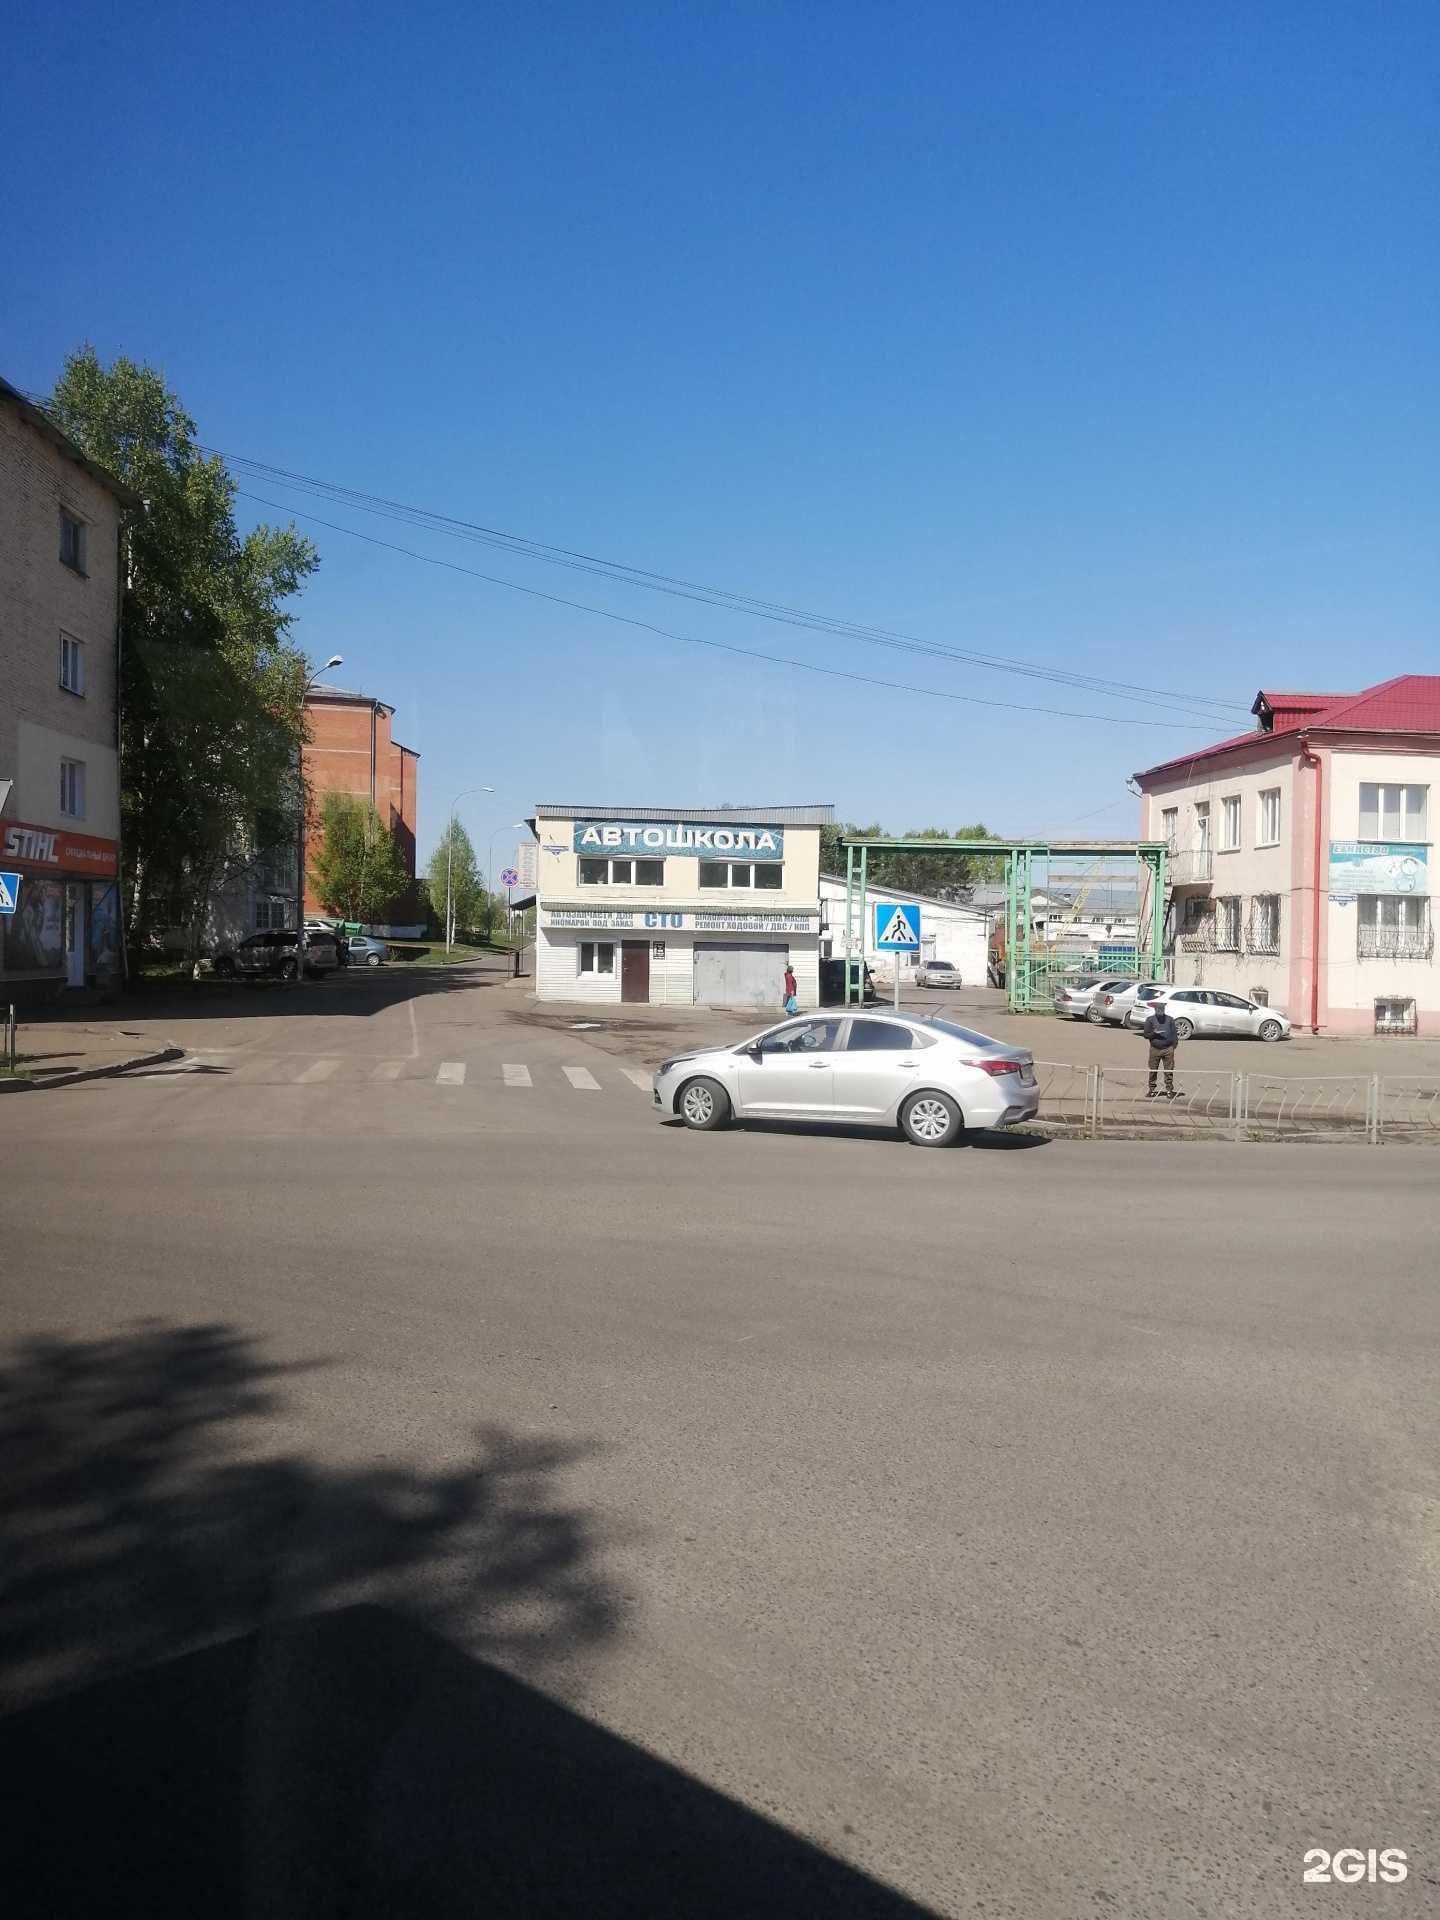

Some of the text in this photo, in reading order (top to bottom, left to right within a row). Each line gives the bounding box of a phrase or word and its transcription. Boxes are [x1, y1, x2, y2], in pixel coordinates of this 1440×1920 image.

[5, 827, 59, 863] STIHL
[580, 825, 777, 850] АВТОШКОЛА
[550, 919, 634, 928] ИНОМАРОК ПОД ЗАКАЗ
[644, 911, 684, 928] СТО
[695, 921, 725, 929] РЕМОНТ
[726, 921, 764, 930] ХОДОВОЙ
[771, 922, 787, 931] ДВС
[794, 923, 810, 931] КПП
